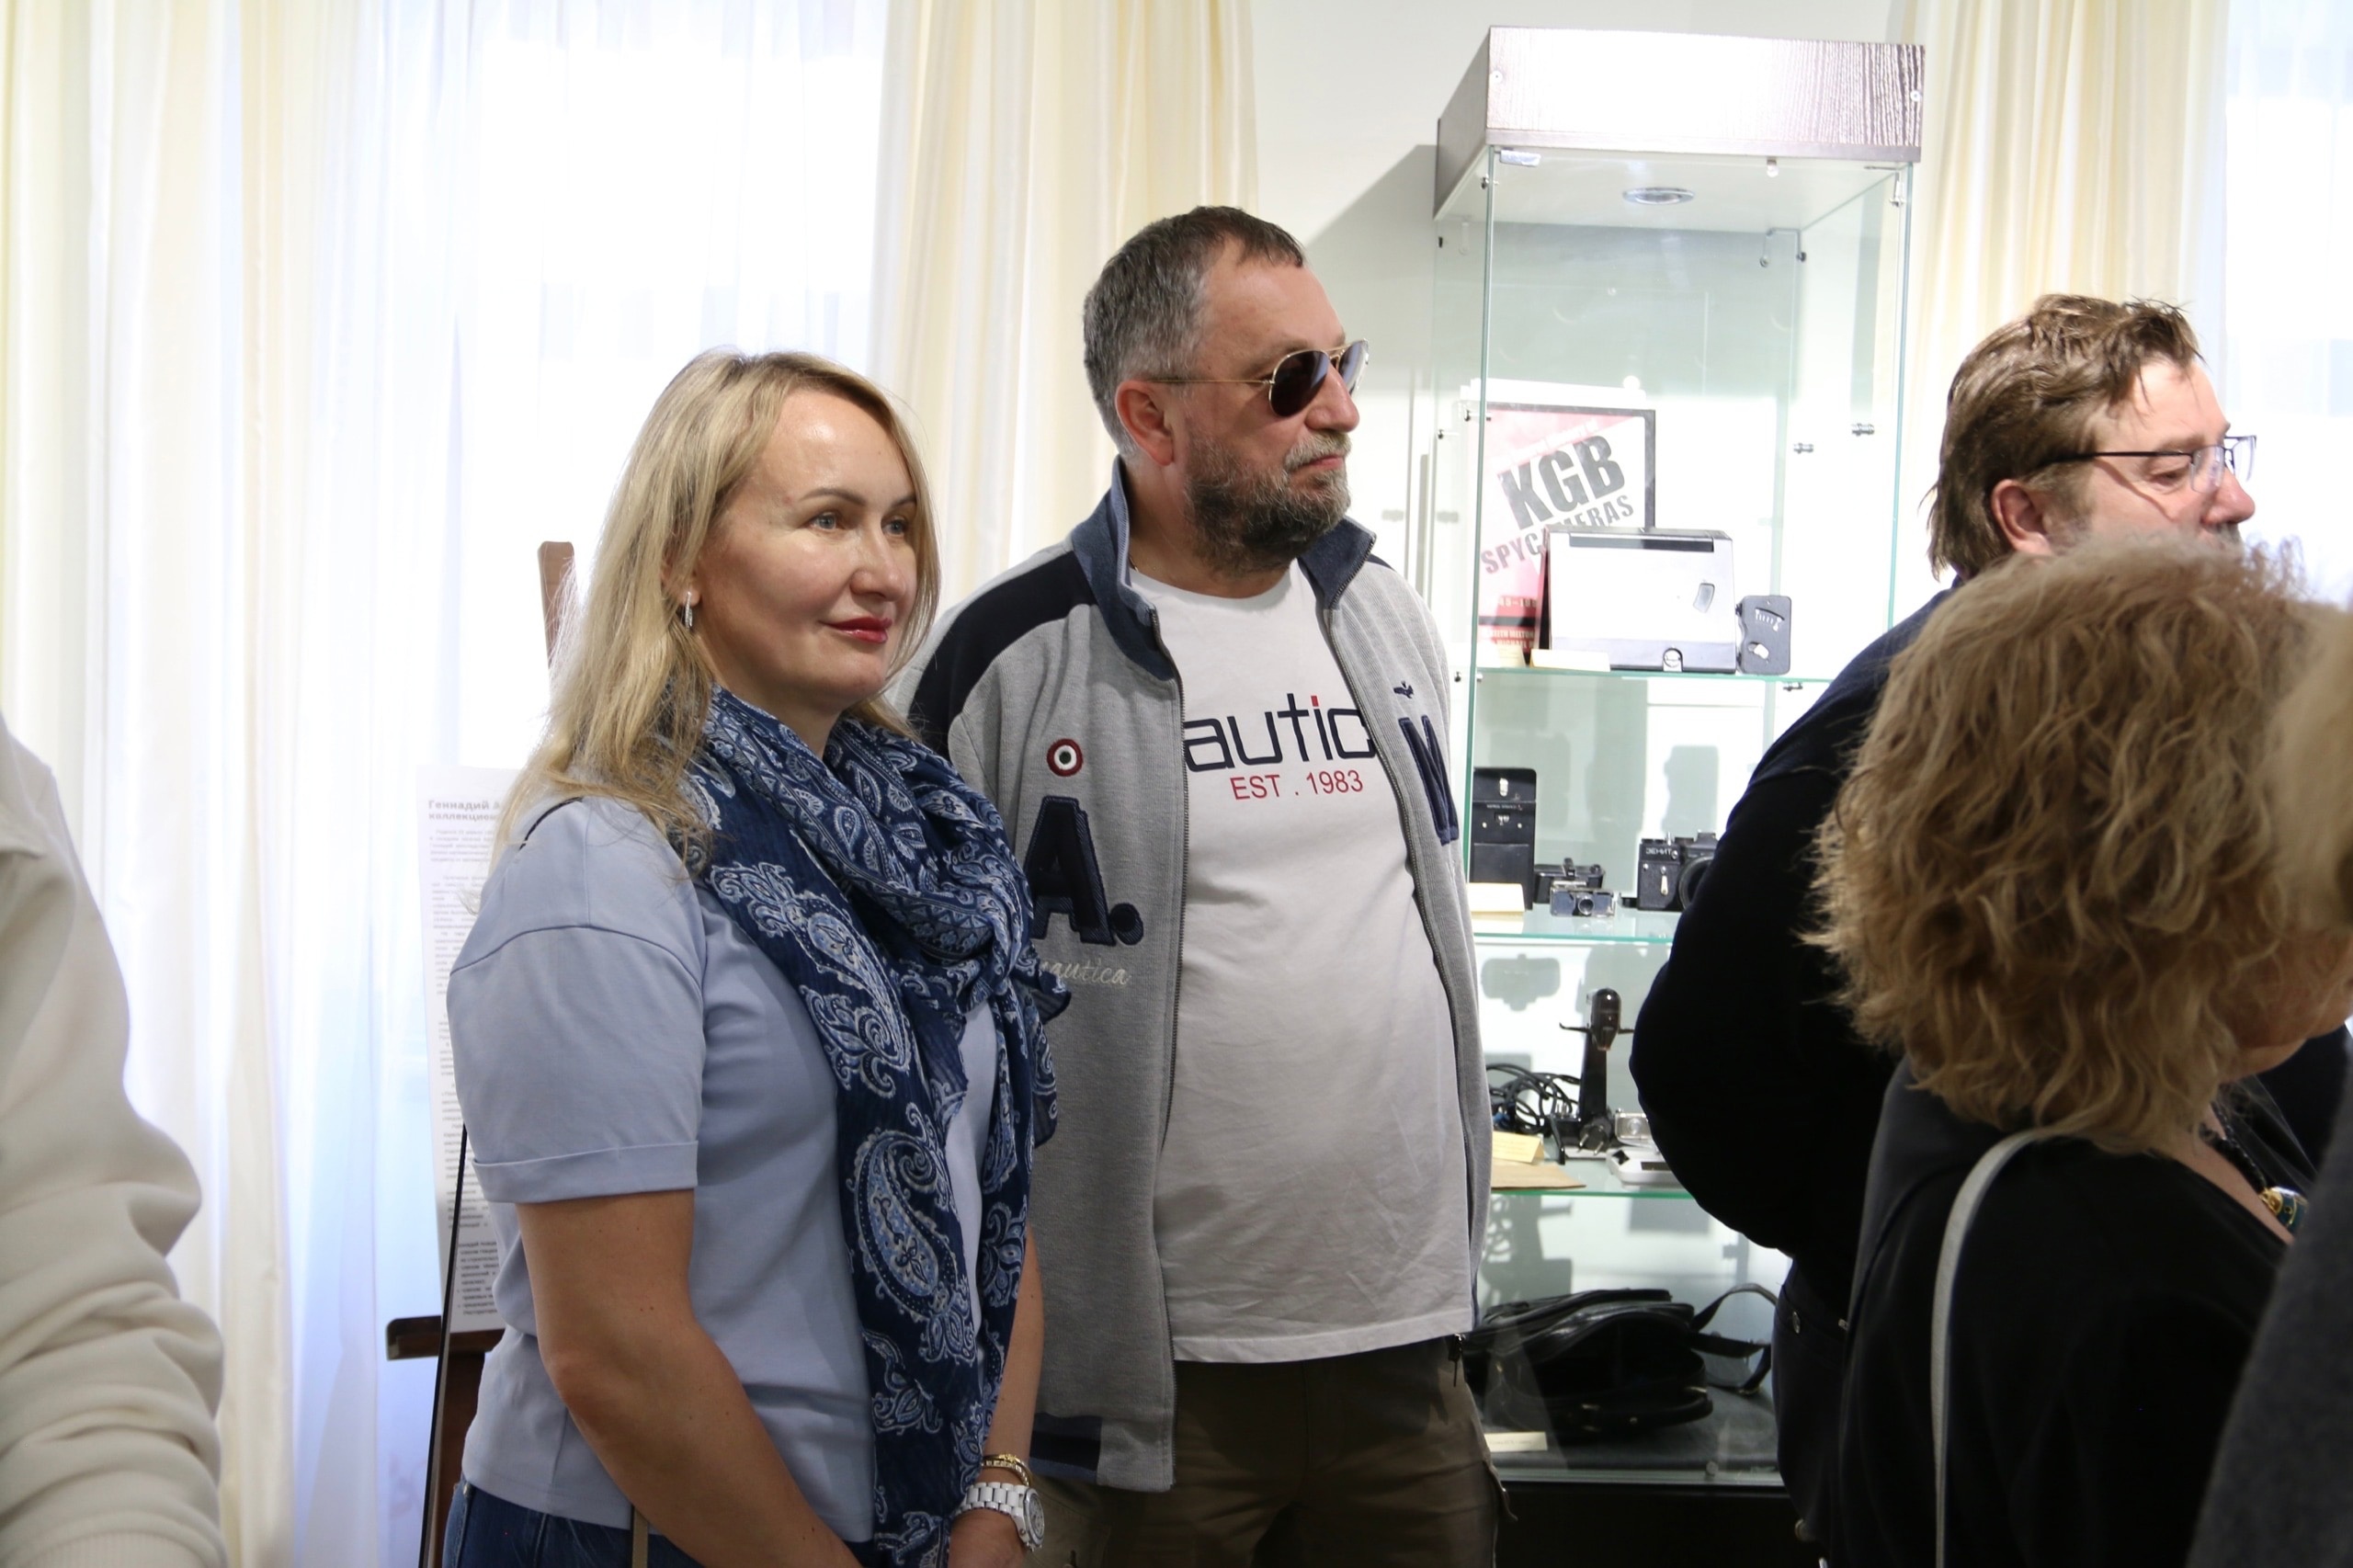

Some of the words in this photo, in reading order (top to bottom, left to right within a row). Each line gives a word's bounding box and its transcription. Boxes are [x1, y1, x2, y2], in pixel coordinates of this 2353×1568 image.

[1498, 434, 1626, 530] KGB
[1230, 775, 1281, 801] EST
[1306, 769, 1364, 795] 1983
[428, 800, 490, 812] Геннадий
